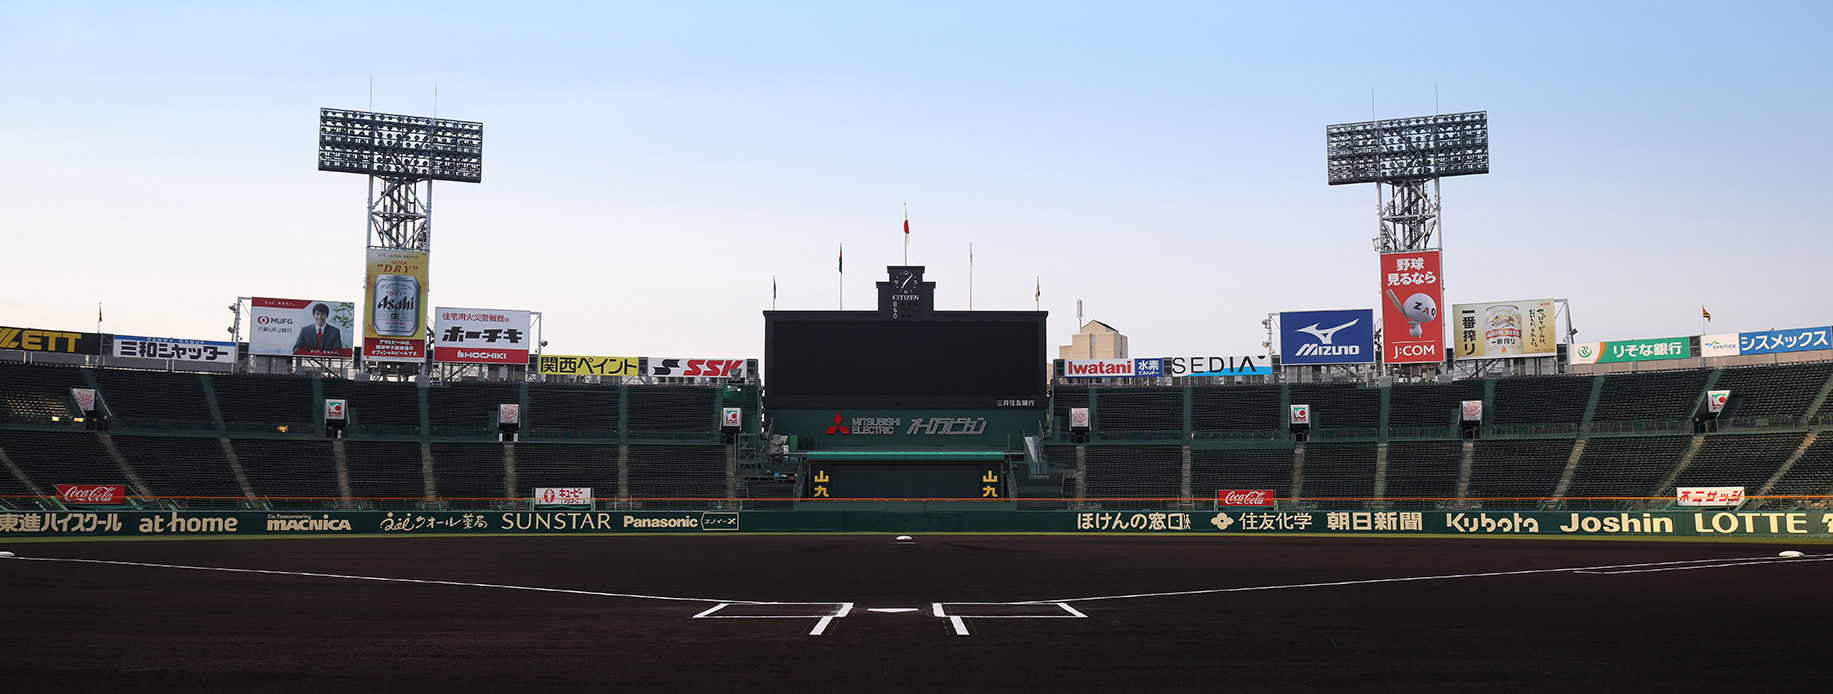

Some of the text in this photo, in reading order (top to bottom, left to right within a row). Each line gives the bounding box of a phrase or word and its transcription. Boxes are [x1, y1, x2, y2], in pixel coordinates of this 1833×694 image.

[1396, 257, 1424, 271] 野球
[1387, 271, 1436, 286] 見るなら
[377, 295, 414, 310] Asahi
[442, 326, 523, 343] ホーチキ
[1462, 310, 1476, 355] 一番搾り
[1486, 330, 1504, 338] KIRIN
[1740, 331, 1829, 351] シスメックス
[120, 341, 229, 360] 三和シャッター
[464, 351, 507, 360] HOCHIKI
[1393, 344, 1435, 359] J:COM
[1612, 342, 1682, 357] りそな銀行
[540, 356, 637, 375] 関西ペイント
[683, 359, 744, 376] SSK
[1068, 360, 1132, 374] Iwatani
[1138, 360, 1159, 370] 水素
[852, 417, 901, 426] MITSUBISHI
[852, 426, 895, 435] ELECTRIC
[814, 470, 829, 497] 山九
[982, 470, 998, 497] 山九
[65, 486, 116, 502] Coca-Cola
[559, 488, 583, 498] キューピー
[1225, 490, 1265, 505] Coca-Cola
[0, 513, 122, 532] 東進ハイスクール
[139, 512, 239, 533] at home
[415, 513, 488, 530] クオール薬局
[501, 513, 612, 530] SUNSTAR
[623, 515, 699, 528] Panasonic
[1238, 512, 1313, 530] 住友化学
[1326, 512, 1423, 531] 朝日新聞
[1446, 512, 1539, 533] Kubota
[1560, 512, 1673, 533] Joshin
[1694, 512, 1808, 533] LOTTE
